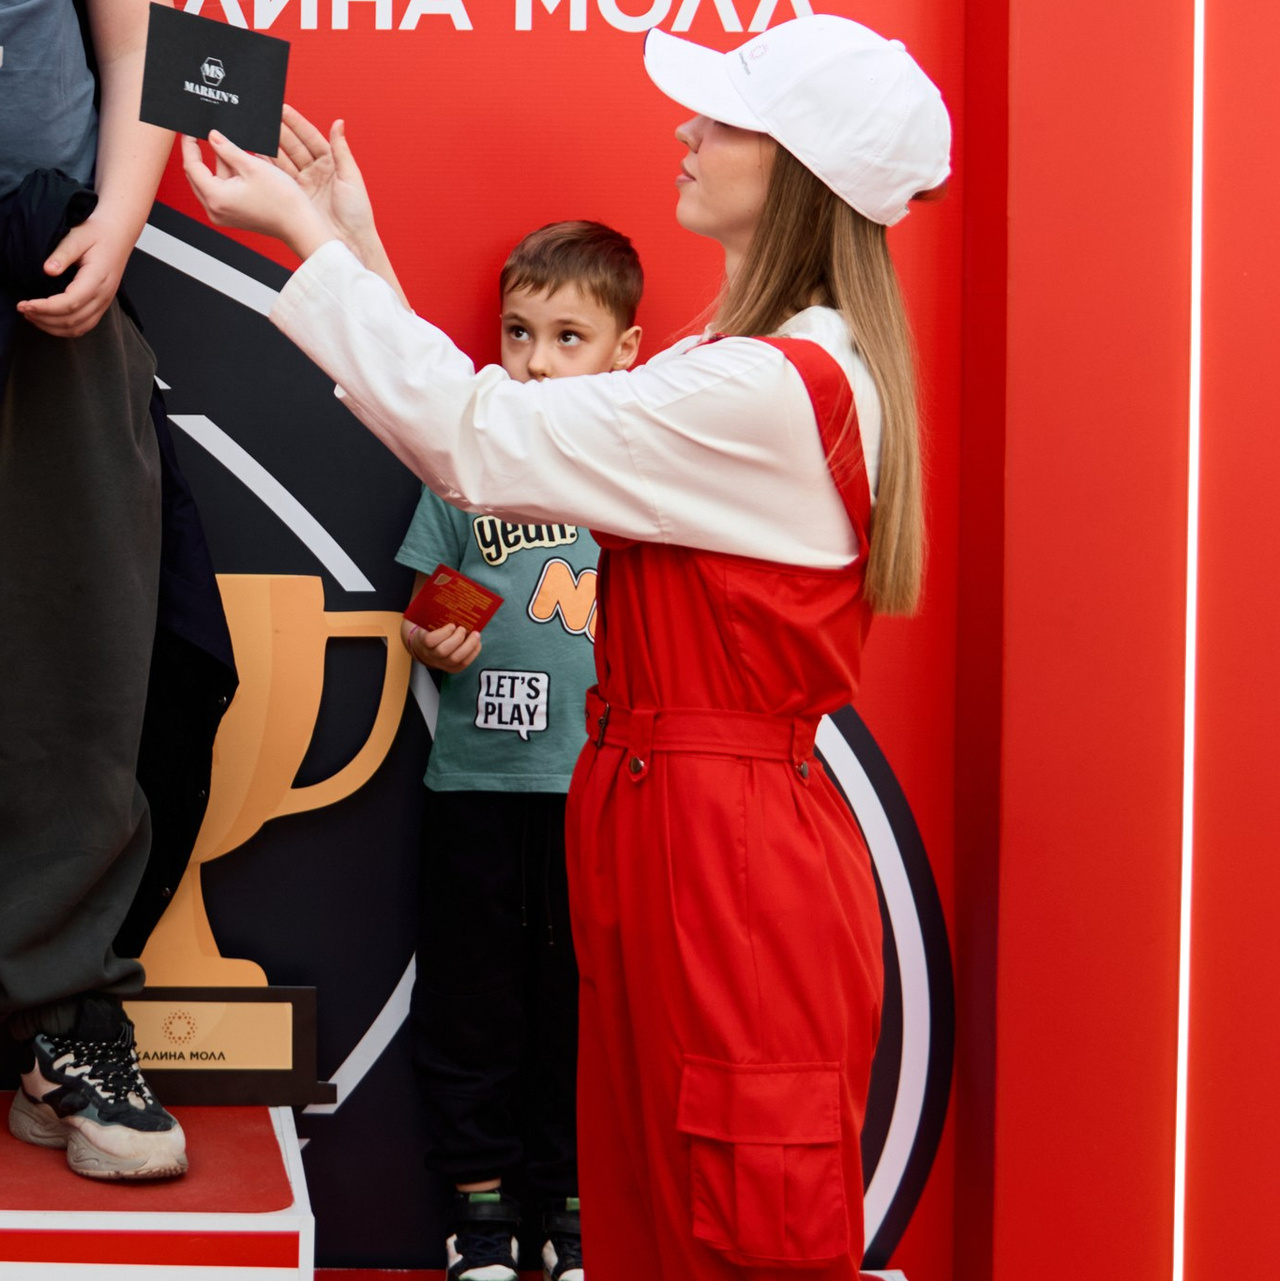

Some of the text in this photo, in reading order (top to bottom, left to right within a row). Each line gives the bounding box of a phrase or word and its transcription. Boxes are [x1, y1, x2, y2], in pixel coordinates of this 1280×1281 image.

[184, 80, 239, 104] MARKIN'S
[485, 674, 541, 700] LET'S
[483, 701, 539, 726] PLAY
[190, 1050, 226, 1061] МОЛЛ
